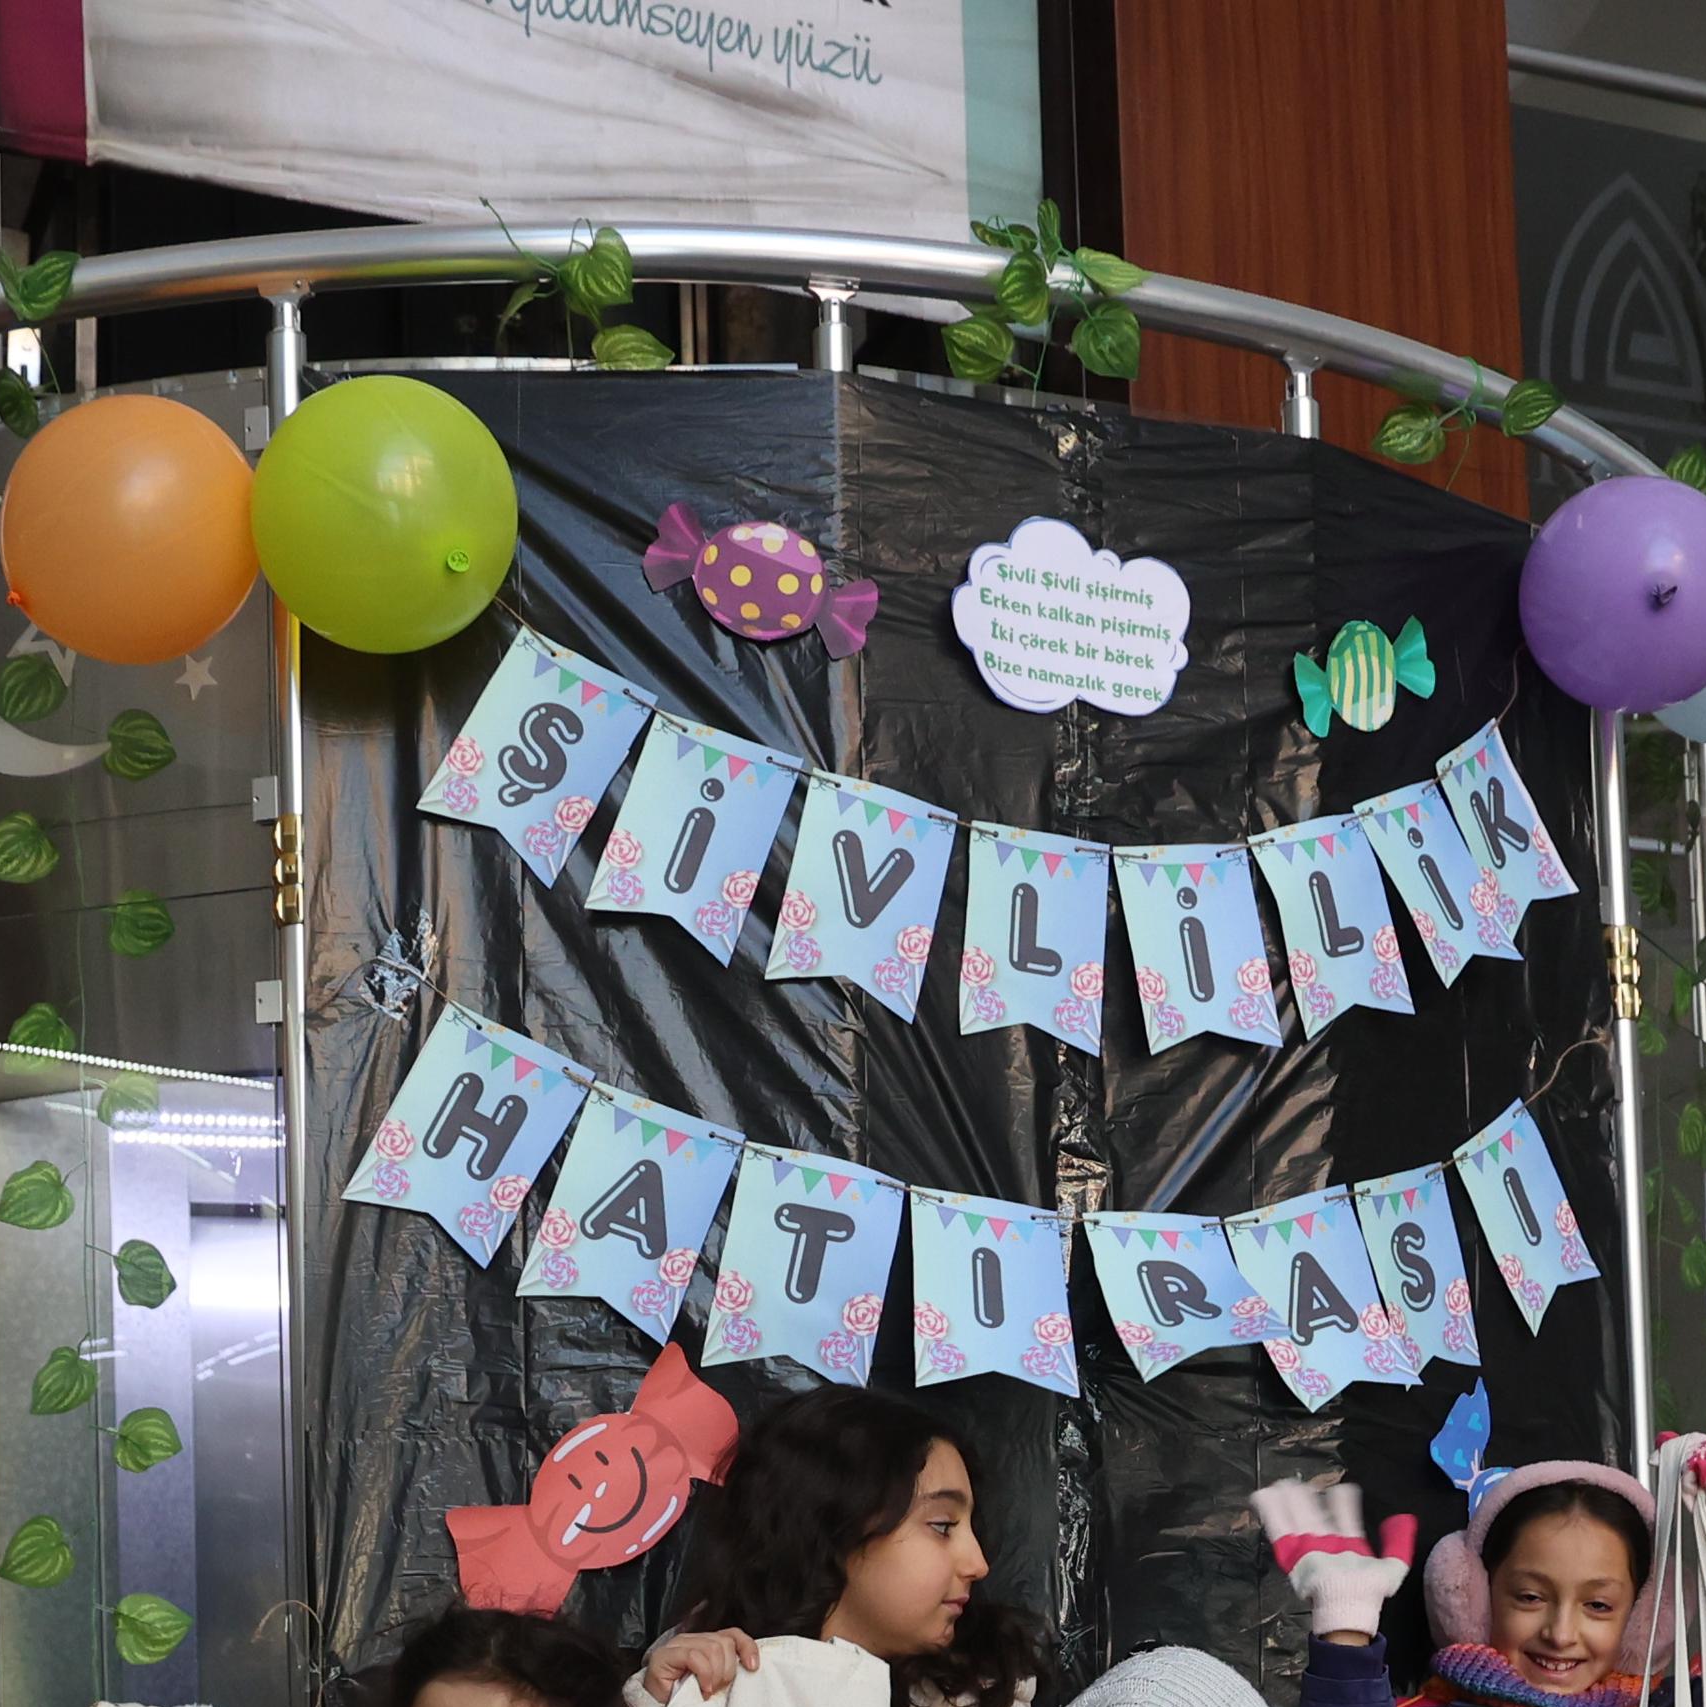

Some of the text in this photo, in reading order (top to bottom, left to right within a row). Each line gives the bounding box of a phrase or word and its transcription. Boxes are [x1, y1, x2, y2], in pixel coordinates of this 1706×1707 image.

[773, 19, 883, 88] yüzü
[996, 562, 1154, 609] Şivli Şivli şişirmiş
[979, 587, 1171, 642] Erken kalkan pişirmiş
[991, 617, 1155, 671] İki çörek bir börek
[983, 651, 1163, 703] Bize namazlık gerek
[496, 701, 1532, 1004] ŞİVLİLİK
[423, 1071, 1543, 1348] HATIRASI
